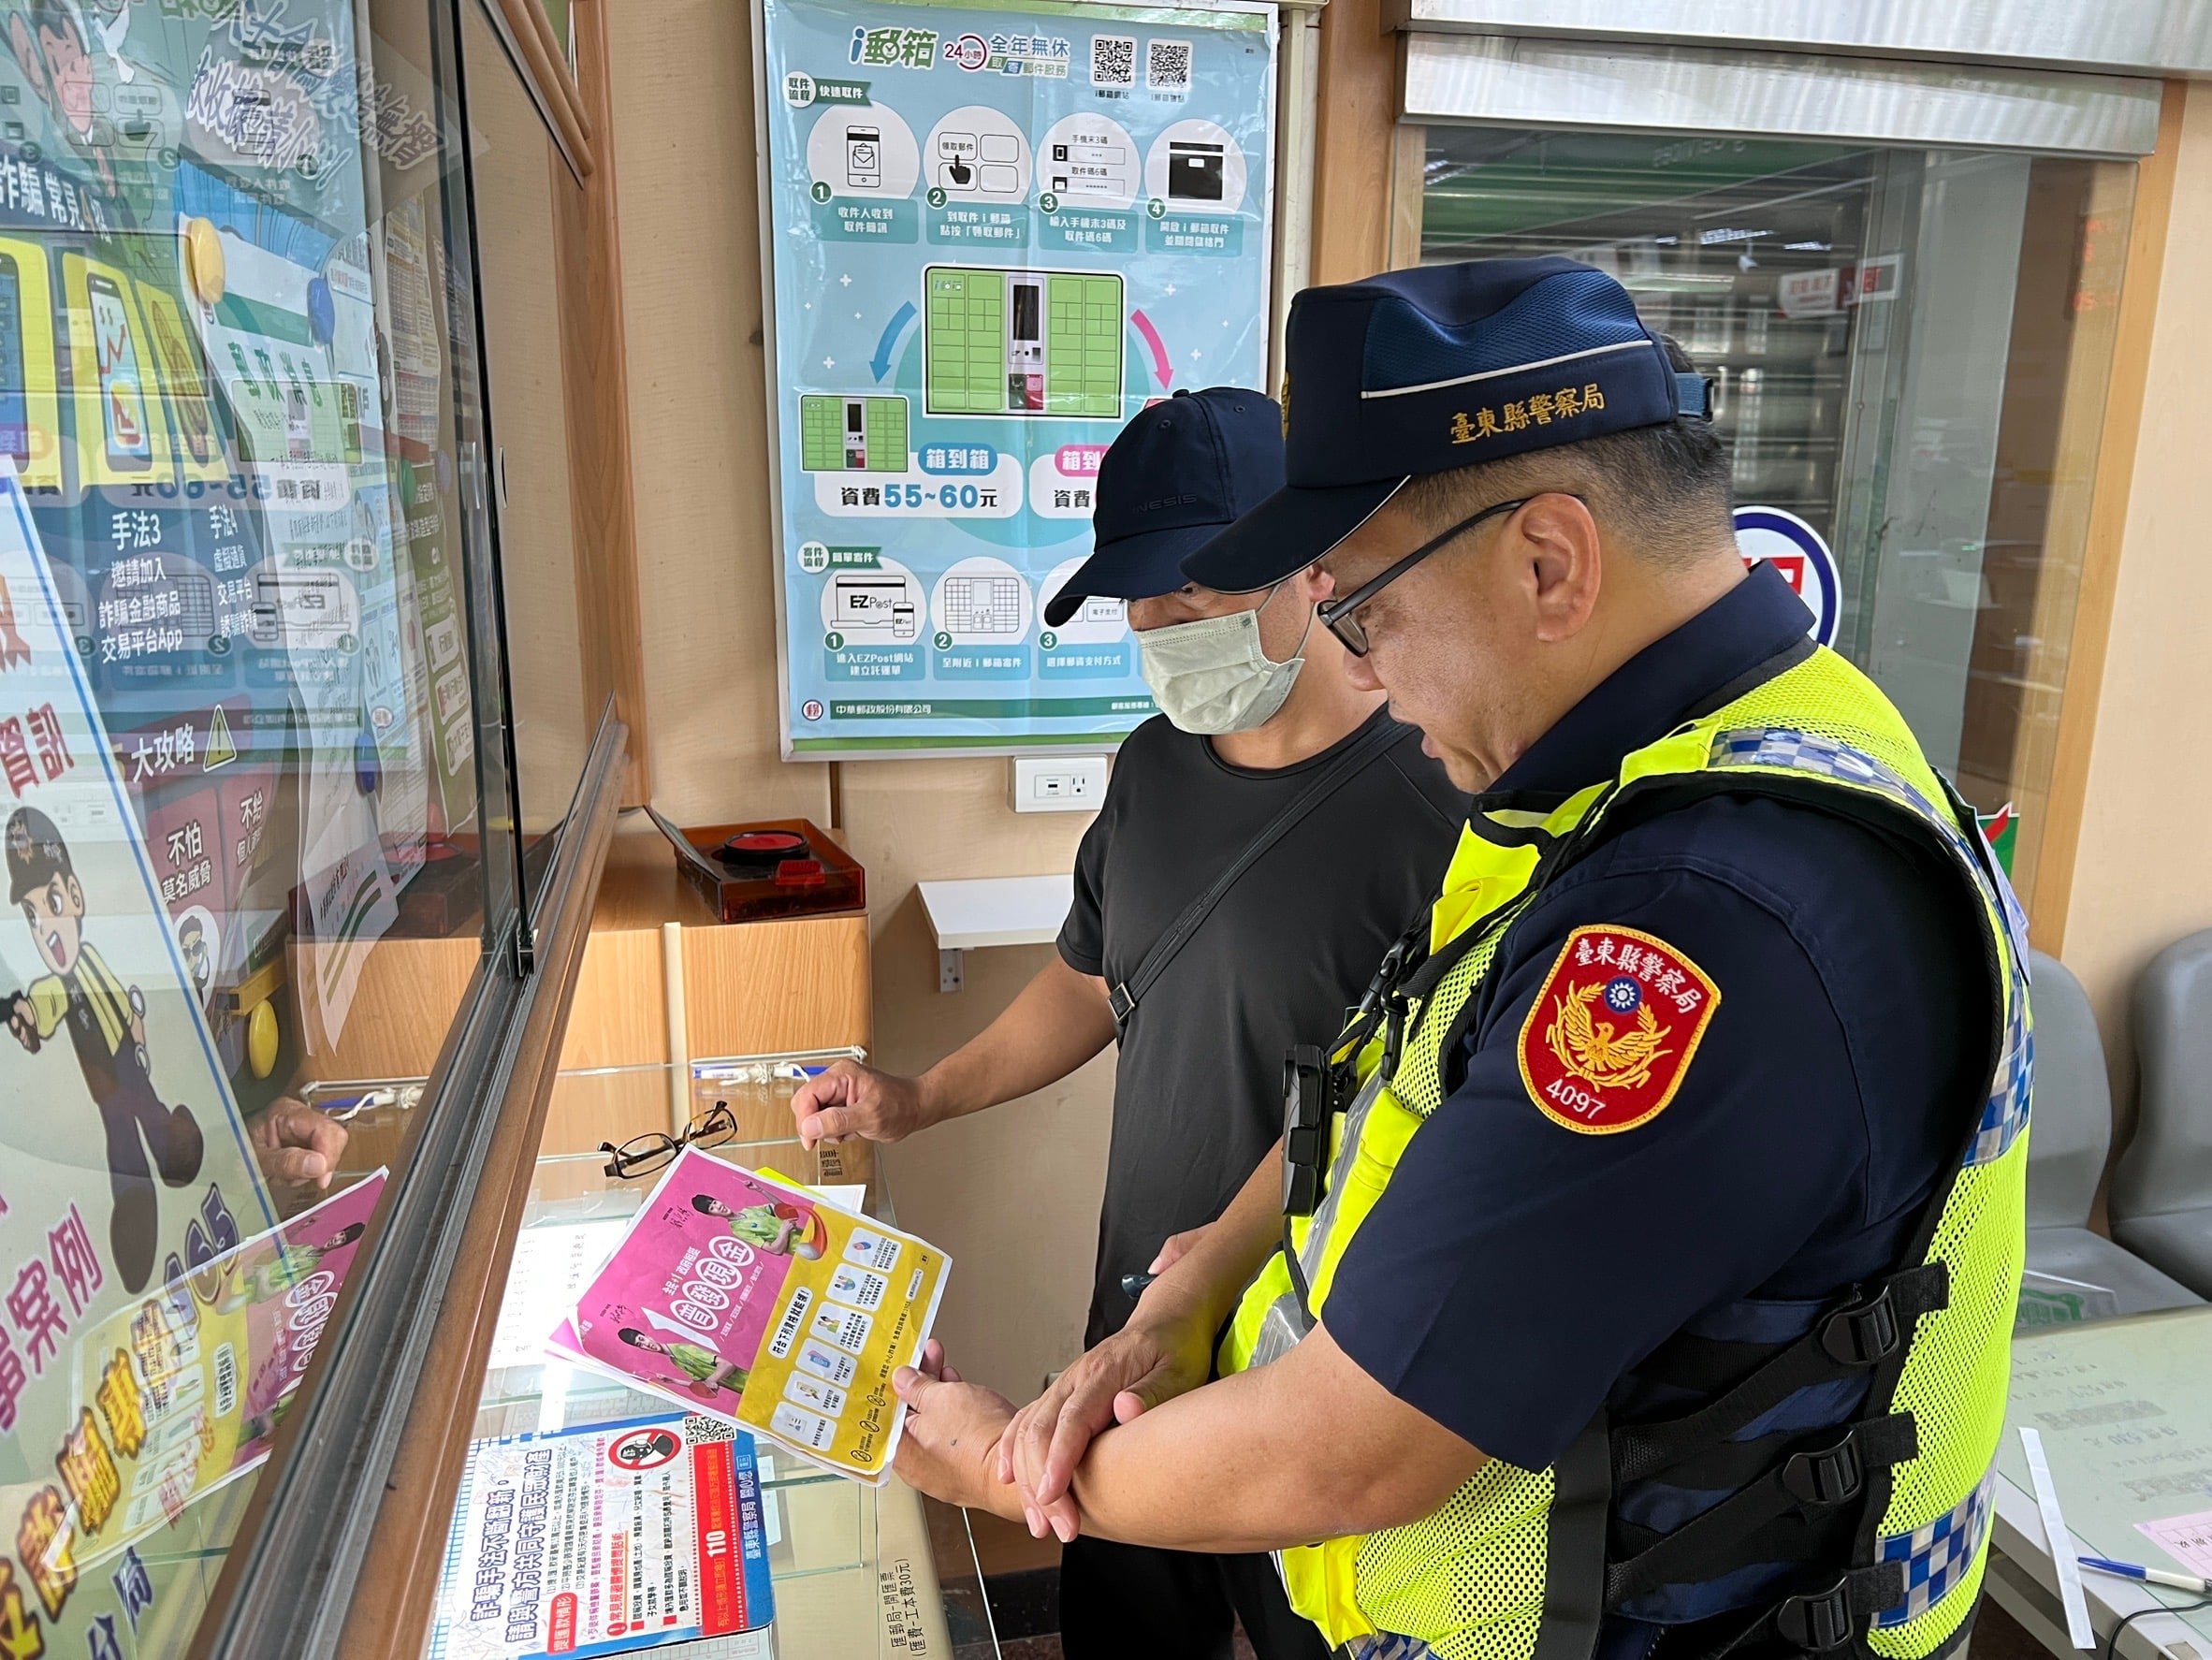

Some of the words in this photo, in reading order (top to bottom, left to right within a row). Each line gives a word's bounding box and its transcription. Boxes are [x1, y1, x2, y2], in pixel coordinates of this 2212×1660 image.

[945, 43, 963, 59] 24
[990, 35, 1070, 58] 全年無休
[788, 78, 810, 90] 取件
[820, 85, 864, 99] 快速取件
[941, 141, 974, 152] 領取郵件
[1072, 134, 1109, 145] 手機末3碼
[1070, 166, 1108, 176] 取件碼6碼
[816, 185, 824, 199] 1
[933, 191, 941, 205] 2
[1044, 196, 1054, 209] 3
[1152, 202, 1161, 215] 4
[837, 206, 894, 220] 收件人收到
[947, 211, 979, 224] 到取件
[1049, 216, 1126, 231] 輸入手機末3碼及
[1065, 230, 1113, 243] 取件碼6碼
[1450, 383, 1606, 444] 臺東縣警察局
[924, 448, 990, 472] 箱到箱
[1061, 450, 1102, 472] 箱到
[1054, 488, 1091, 509] 資費
[111, 509, 162, 551] 手法3
[832, 552, 874, 563] 簡單寄件
[110, 556, 167, 590] 邀請加入
[216, 575, 255, 607] 交易平台
[850, 594, 892, 609] EZPost
[97, 590, 182, 631] 詐騙金融商品
[101, 628, 183, 665] 交易平台App
[830, 634, 837, 648] 1
[939, 635, 948, 648] 2
[1044, 635, 1054, 647] 3
[837, 652, 914, 663] 進入EZPost網站
[1046, 655, 1122, 667] 選擇郵資支付方式
[850, 664, 901, 677] 建立託運單
[836, 704, 932, 715] 中華郵政股份有限公司
[130, 721, 196, 784] 大攻略
[167, 818, 204, 866] 不怕
[161, 859, 213, 907] 莫名威脅
[1575, 937, 1703, 1013] 臺東縣警察局
[1546, 1078, 1607, 1119] 4097
[677, 1237, 749, 1328] 普發現金
[742, 1501, 761, 1559] 臺東縣警察局
[505, 1449, 552, 1640] 請與警方共同守護民眾財產
[706, 1530, 726, 1556] 110
[551, 1596, 572, 1651] 提匯款情形
